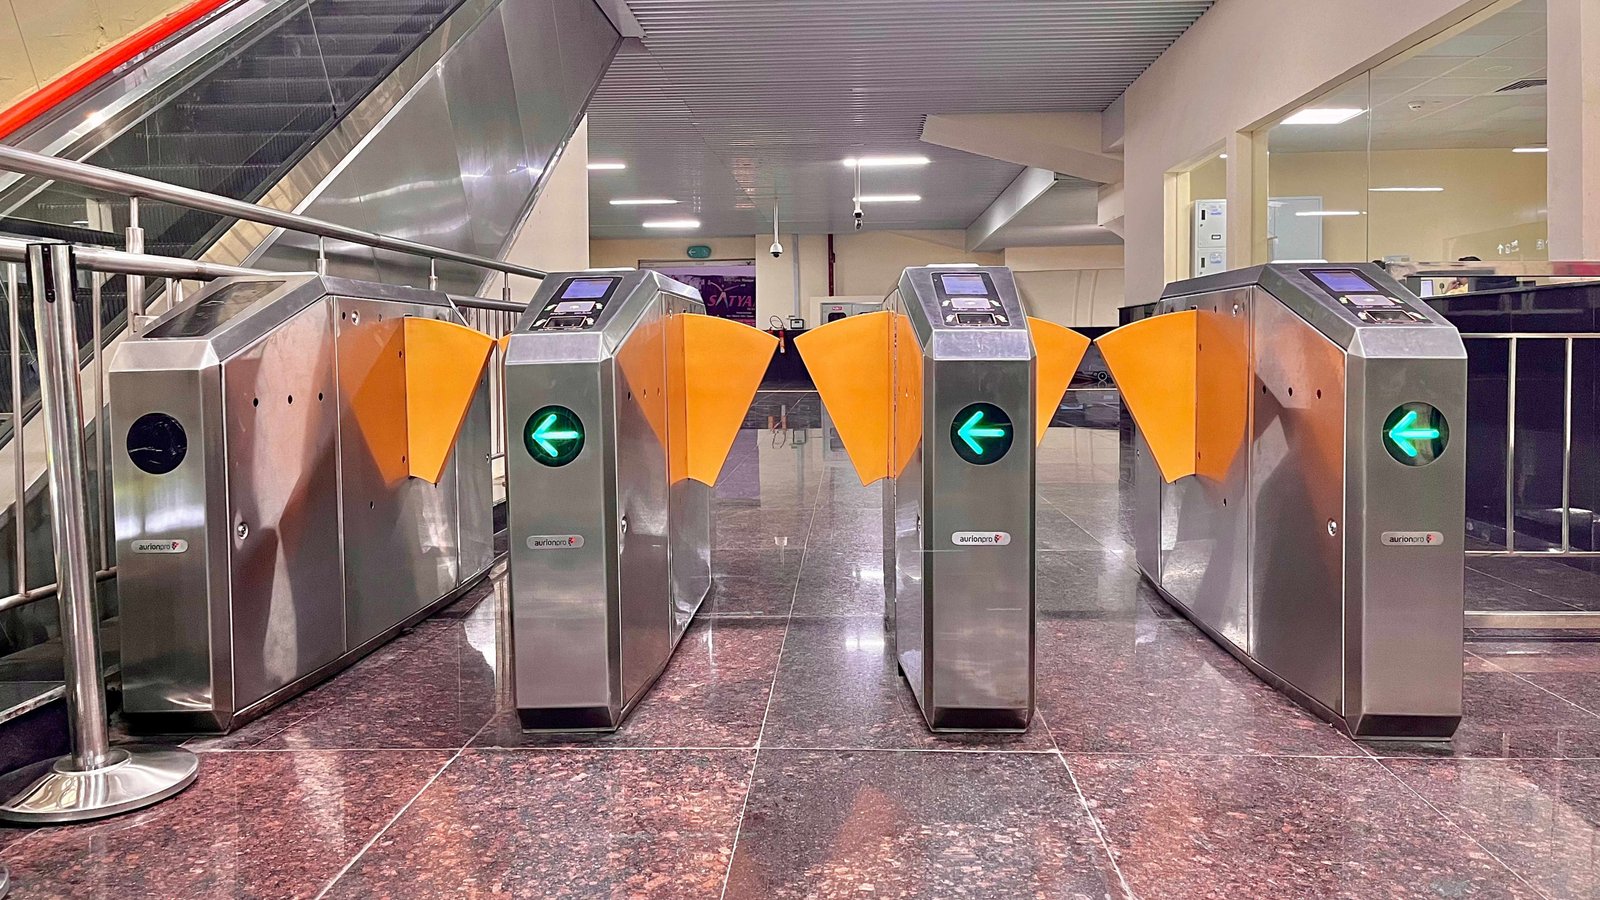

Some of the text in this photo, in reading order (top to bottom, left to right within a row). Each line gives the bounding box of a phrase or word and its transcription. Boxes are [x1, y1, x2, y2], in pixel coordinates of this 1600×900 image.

[707, 292, 755, 308] SATYA
[534, 538, 567, 547] aurionpro
[960, 535, 993, 543] aurionpro
[1389, 535, 1425, 543] aurionpro
[138, 542, 171, 551] aurionpro
